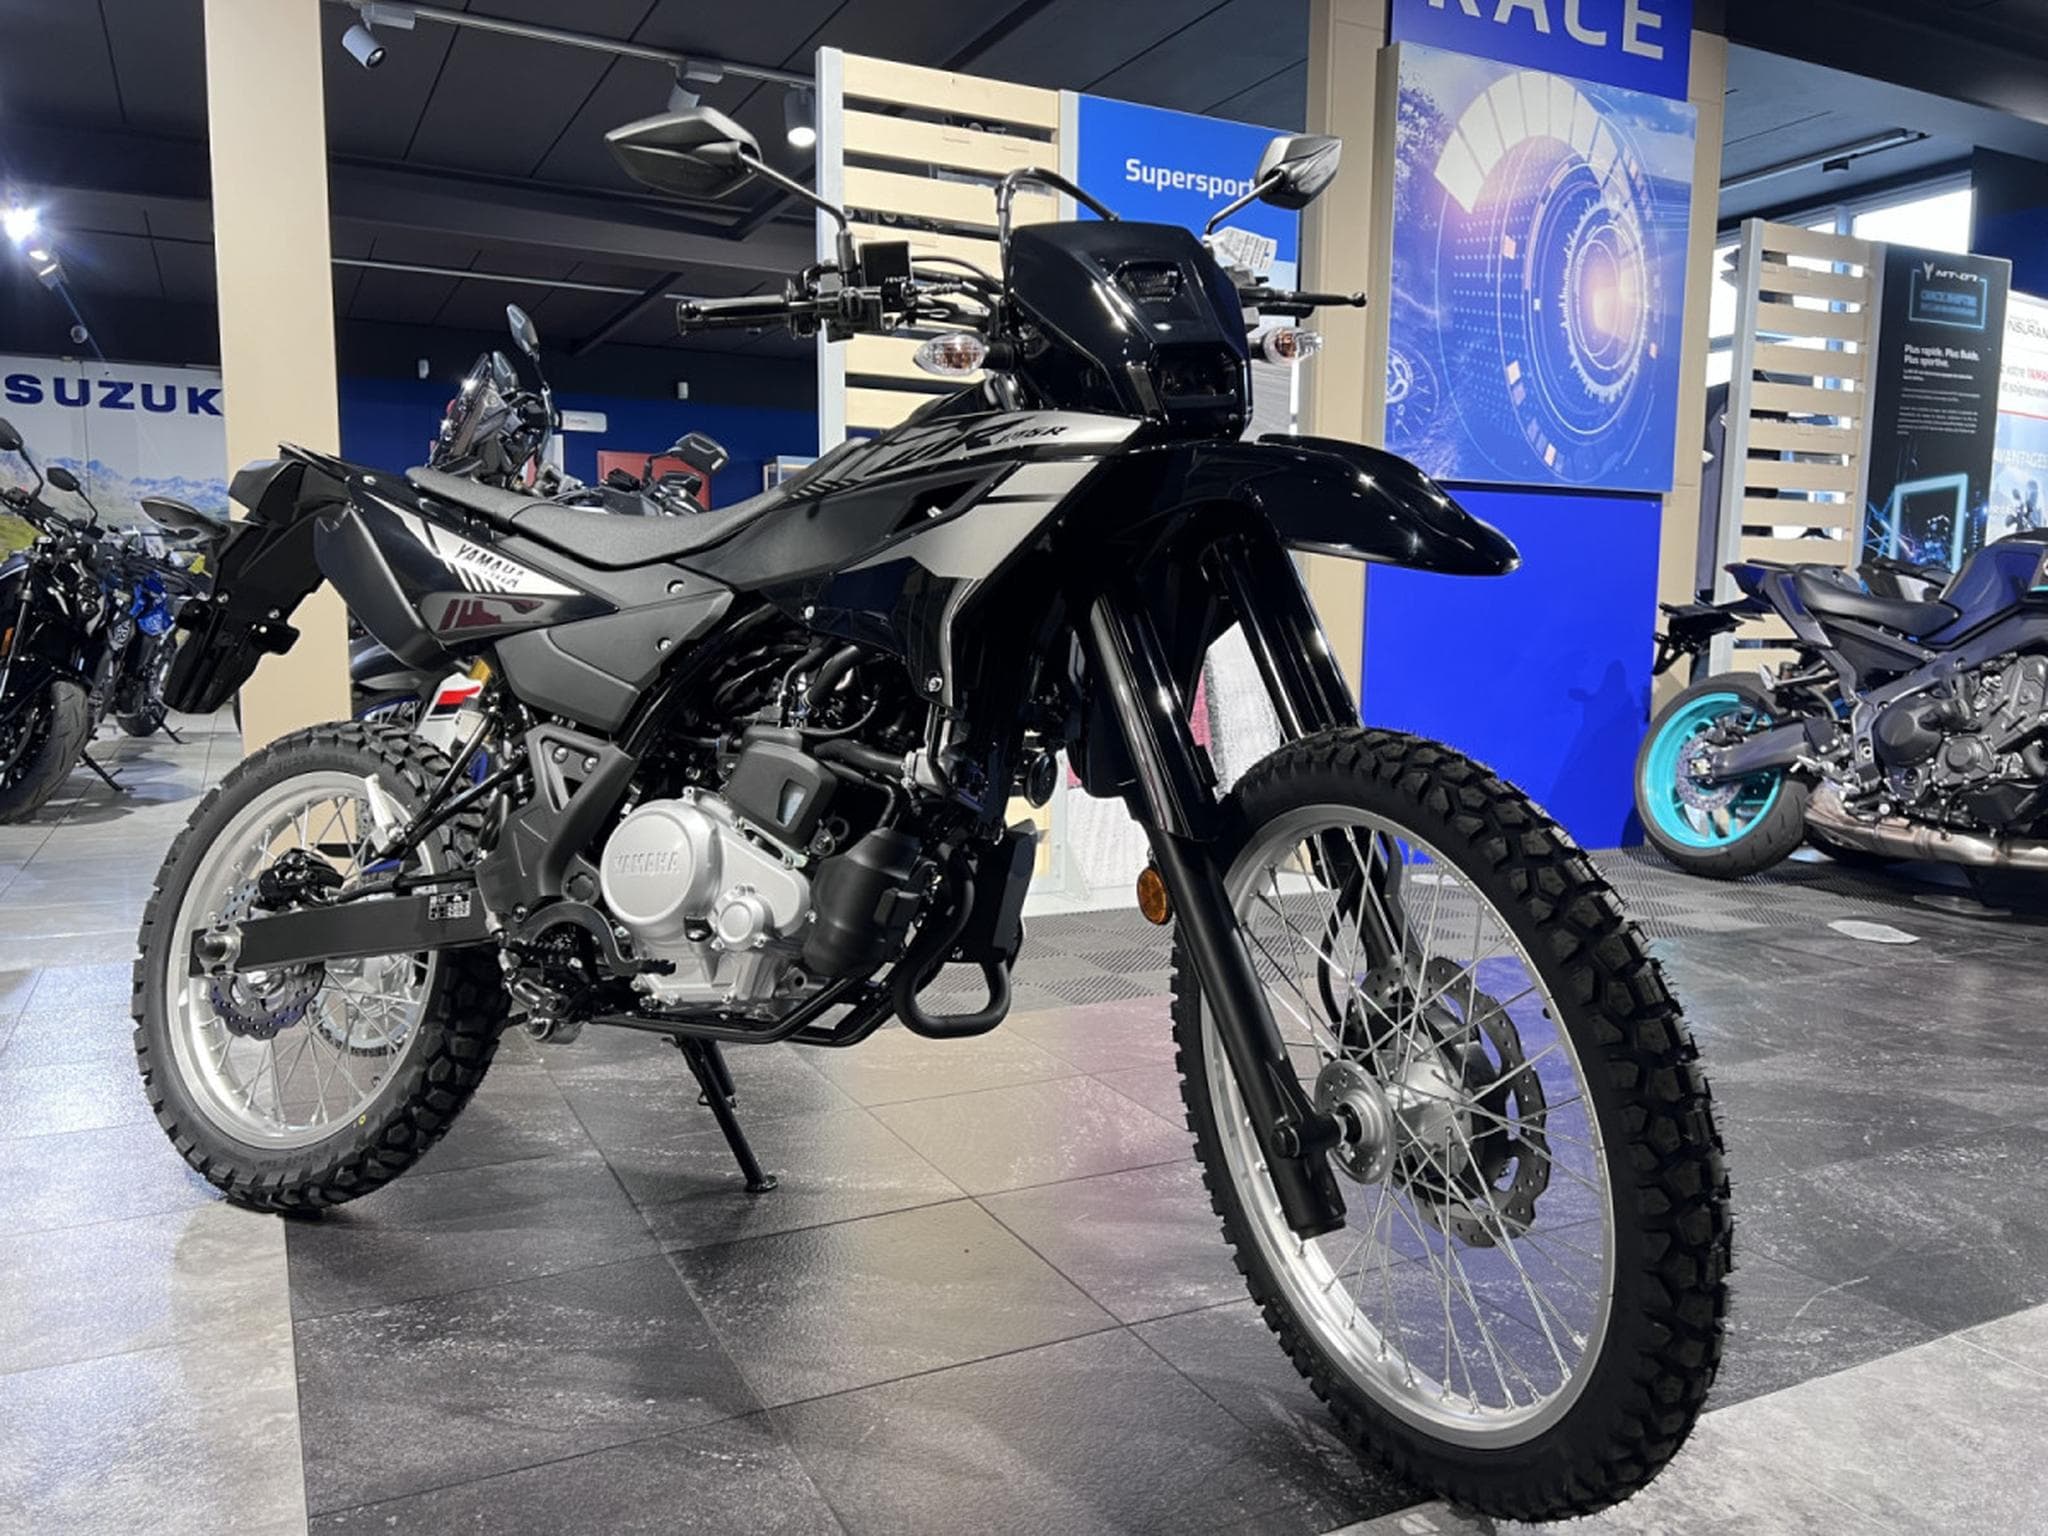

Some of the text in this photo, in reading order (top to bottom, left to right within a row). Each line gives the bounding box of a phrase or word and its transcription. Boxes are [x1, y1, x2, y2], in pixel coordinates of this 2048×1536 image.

[1429, 0, 1664, 60] CE
[1125, 158, 1255, 199] Supersport
[4, 373, 223, 417] SUZUK
[615, 851, 680, 874] YAMAHA
